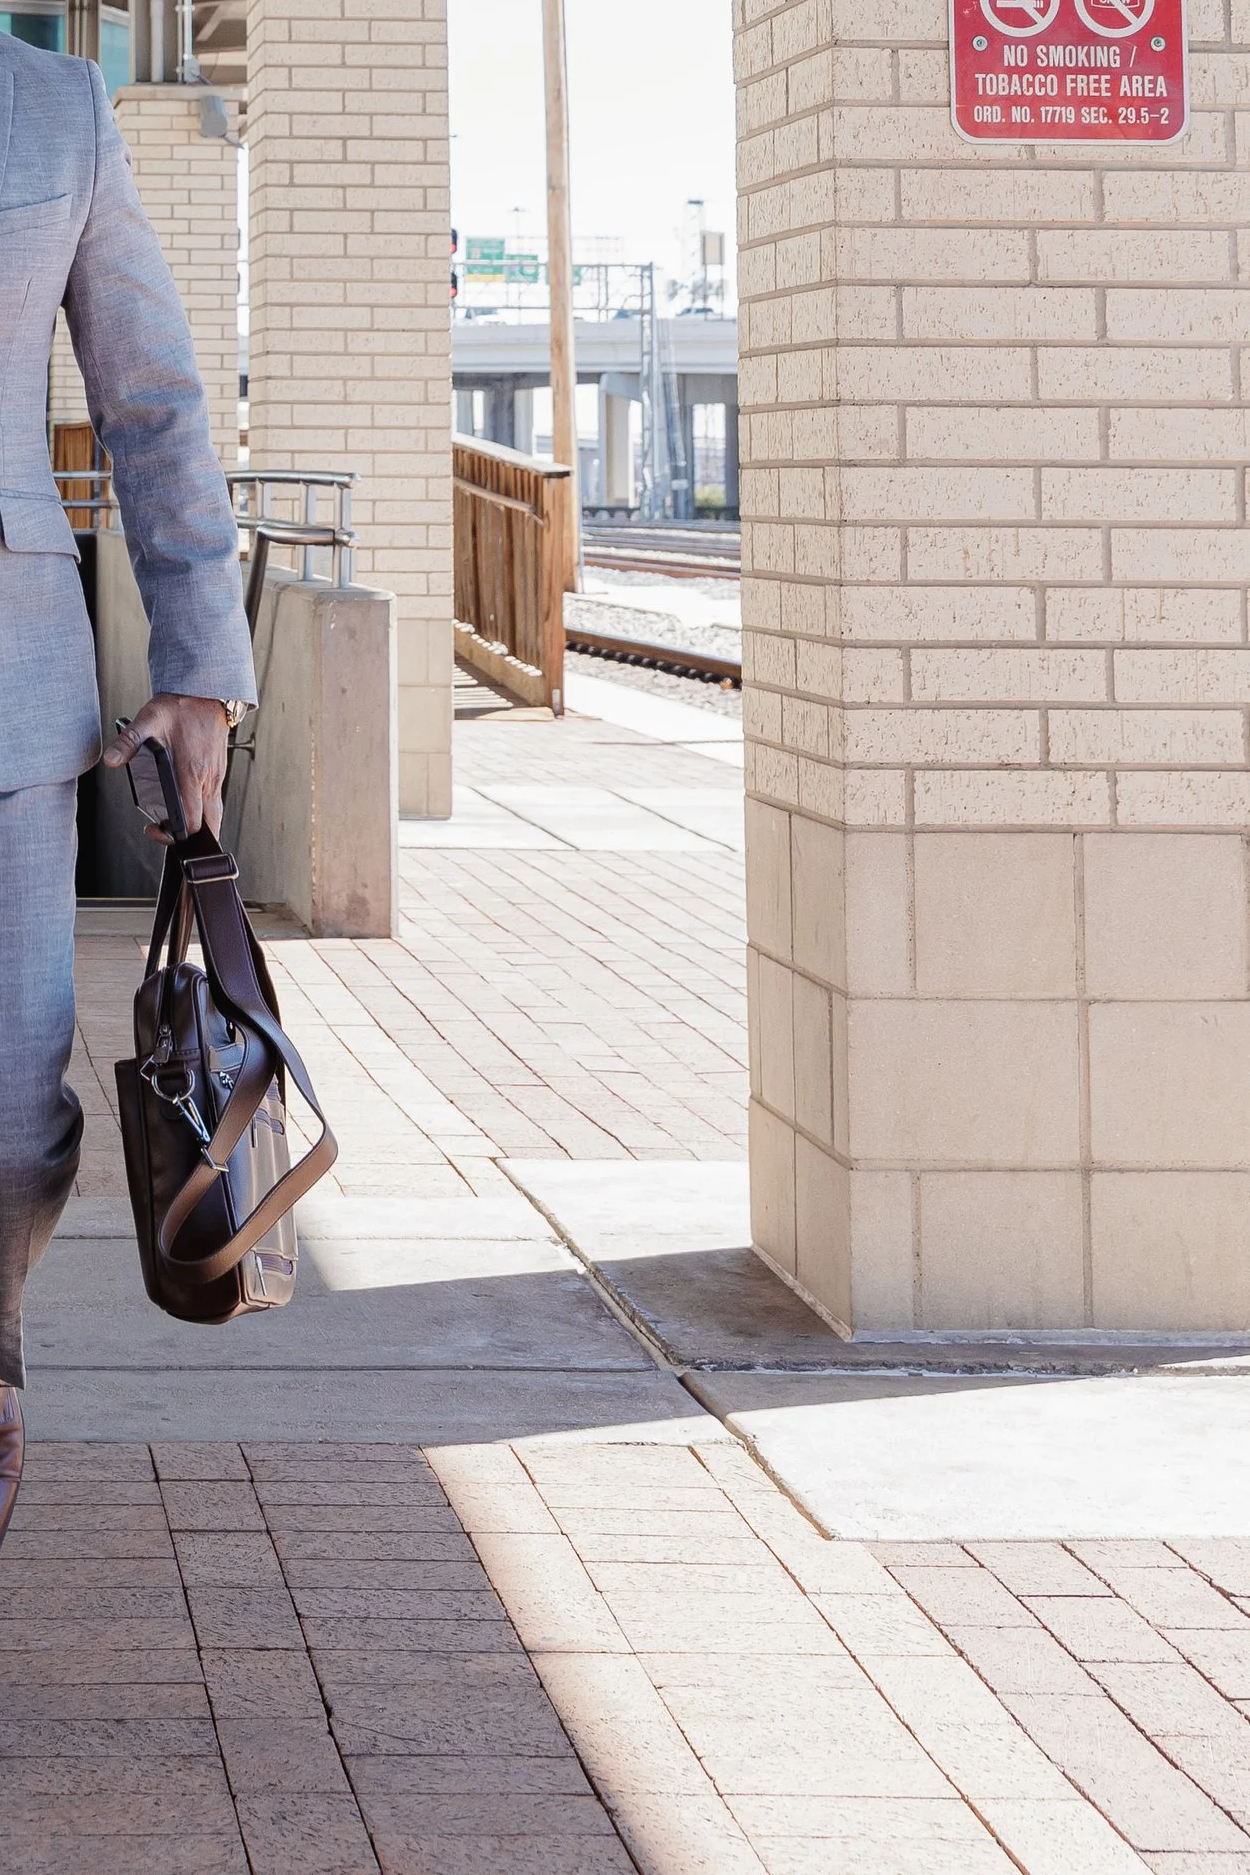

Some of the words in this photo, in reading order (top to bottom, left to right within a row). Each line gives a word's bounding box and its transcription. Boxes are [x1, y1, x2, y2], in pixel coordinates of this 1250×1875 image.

[1004, 45, 1027, 66] NO
[1037, 45, 1120, 67] SMOKING
[975, 74, 1058, 96] TOBACCO
[1067, 75, 1111, 96] FREE
[1120, 76, 1167, 97] AREA
[974, 106, 1005, 122] ORD.
[1012, 106, 1034, 122] NO.
[1040, 106, 1075, 123] 17719
[1081, 107, 1112, 123] SEC.
